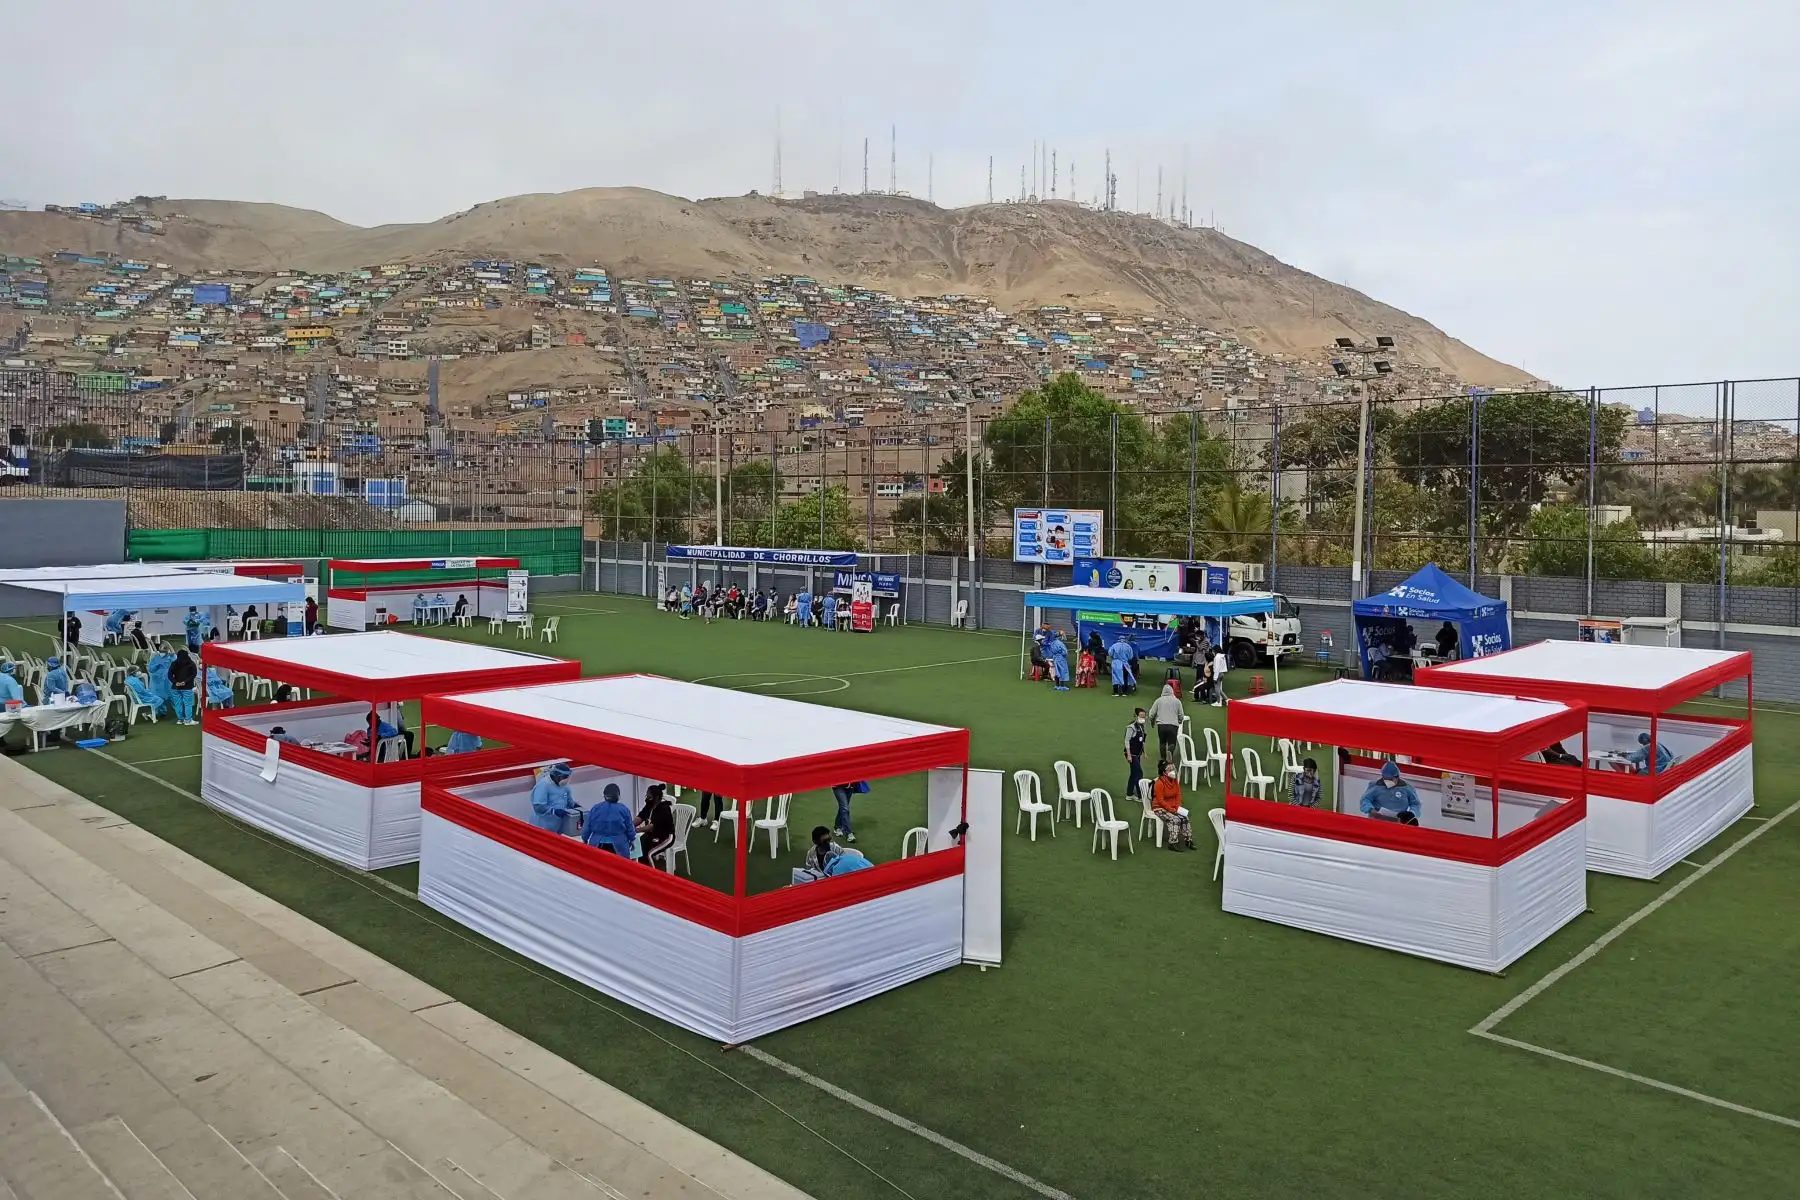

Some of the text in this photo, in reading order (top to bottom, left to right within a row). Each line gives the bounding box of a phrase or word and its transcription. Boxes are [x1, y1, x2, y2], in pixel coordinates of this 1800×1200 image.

[687, 549, 831, 563] MUNICIPALIDAD DE CHORRILLOS
[1408, 587, 1435, 597] Socios
[1417, 594, 1440, 604] Salud
[1484, 633, 1501, 645] Socios
